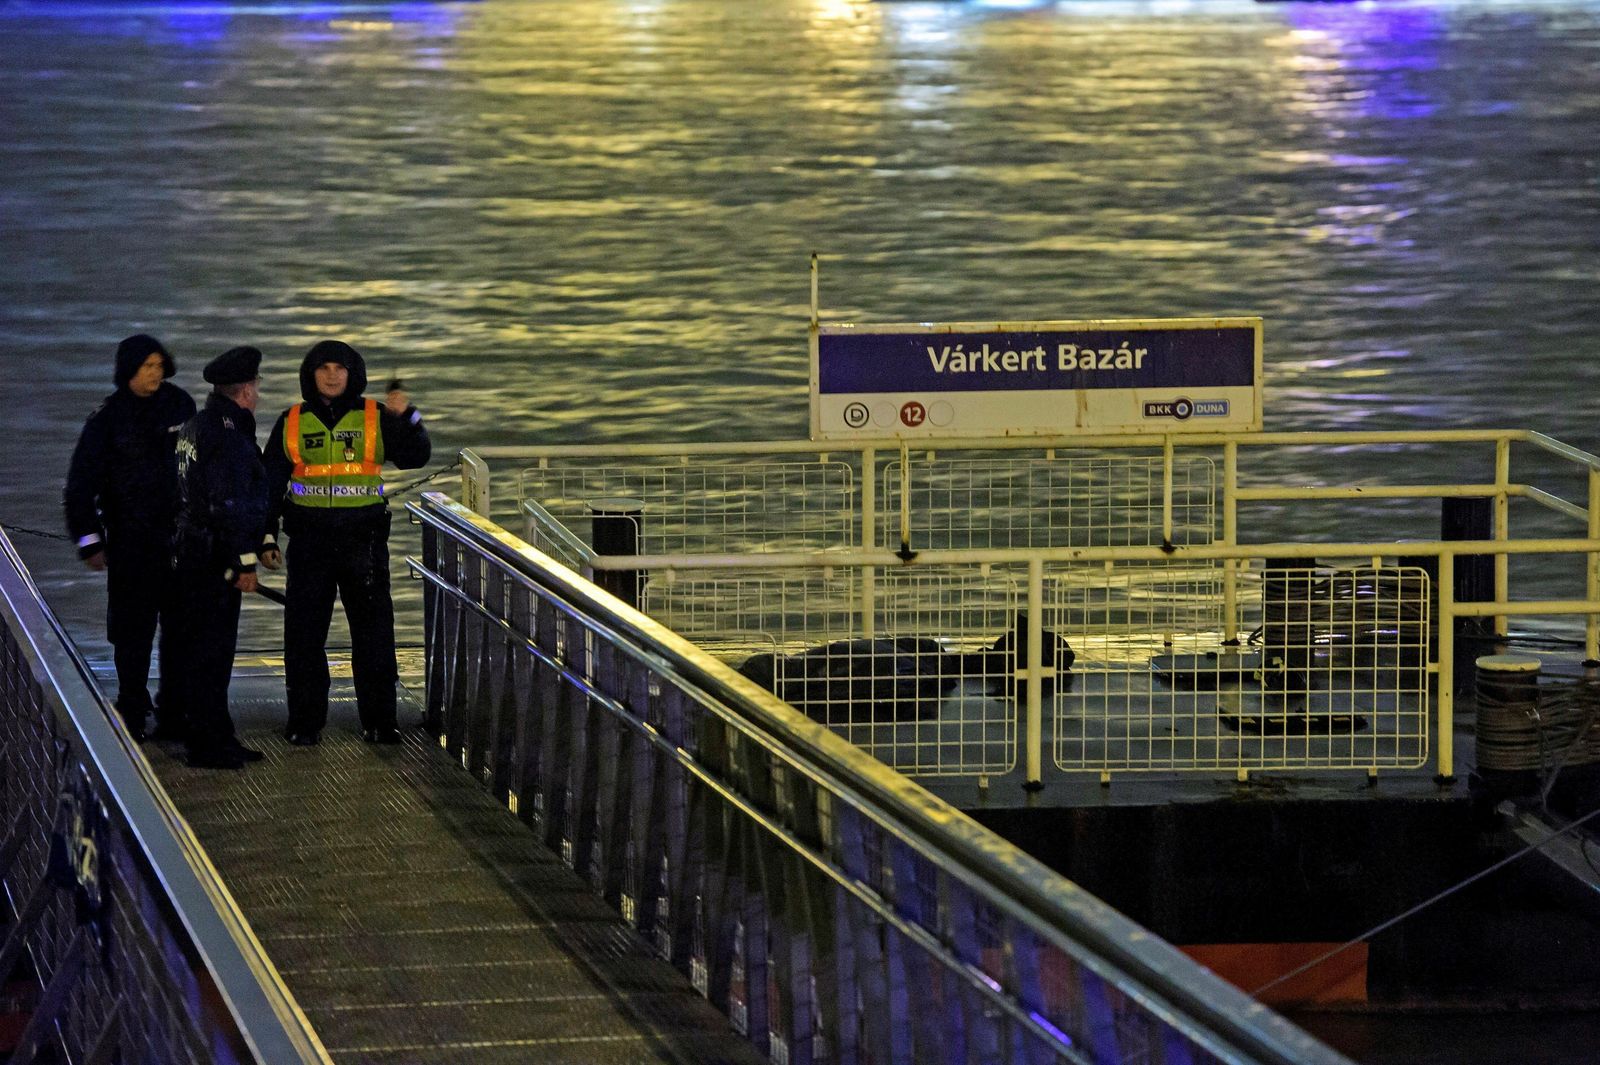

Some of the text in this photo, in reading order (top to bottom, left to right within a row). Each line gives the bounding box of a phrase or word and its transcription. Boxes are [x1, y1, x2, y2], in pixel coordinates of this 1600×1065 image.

[926, 341, 1148, 373] Várkert Bazár
[850, 408, 864, 422] D
[904, 406, 922, 423] 12
[1149, 403, 1225, 415] BKK DUNA
[336, 430, 361, 439] POLICE
